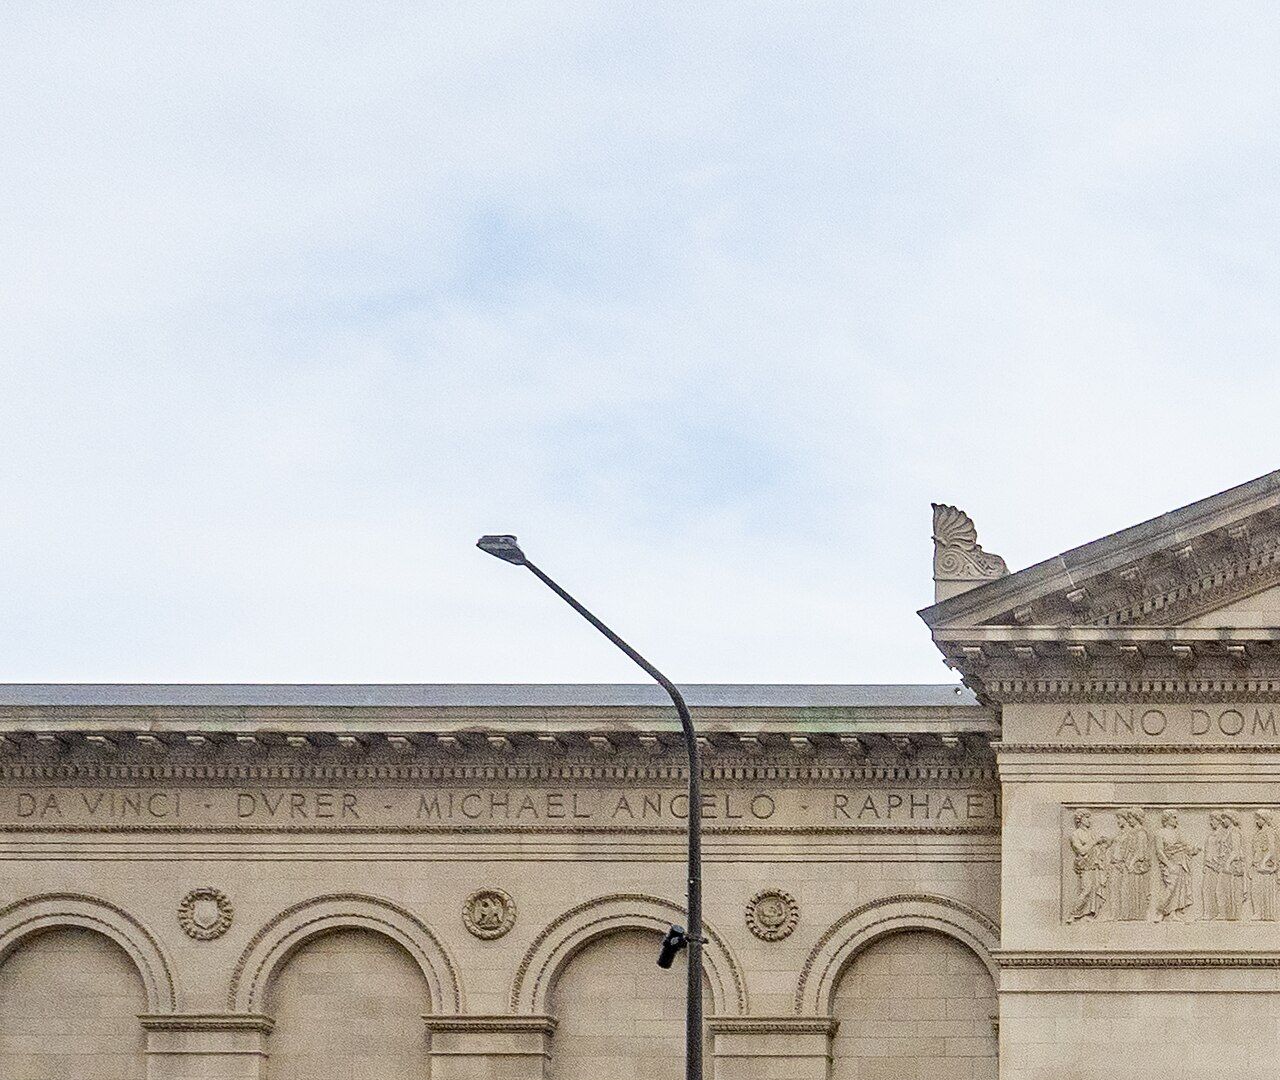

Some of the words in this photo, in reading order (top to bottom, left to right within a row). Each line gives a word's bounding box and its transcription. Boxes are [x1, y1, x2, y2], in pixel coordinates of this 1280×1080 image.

[1055, 708, 1168, 737] ANNO
[16, 792, 63, 818] DA
[81, 792, 182, 818] VINCI
[237, 793, 359, 818] DVRER
[416, 793, 591, 820] MICHAEL
